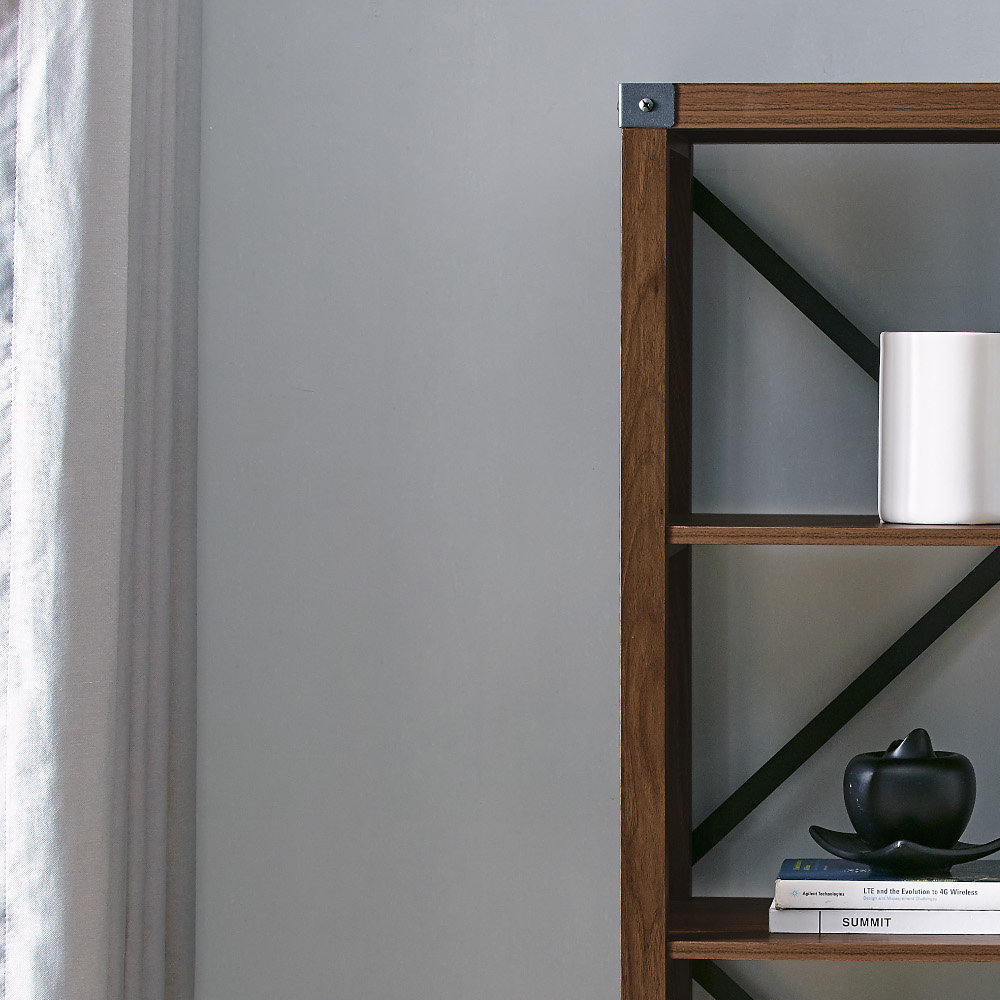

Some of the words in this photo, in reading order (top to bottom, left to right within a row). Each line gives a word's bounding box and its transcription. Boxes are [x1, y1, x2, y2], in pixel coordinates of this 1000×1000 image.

[863, 887, 875, 895] LTE
[876, 887, 888, 895] and
[890, 887, 900, 895] the
[901, 887, 931, 895] Evolution
[939, 888, 949, 896] 4G
[950, 888, 979, 896] Wireless
[842, 917, 892, 928] SUMMIT
